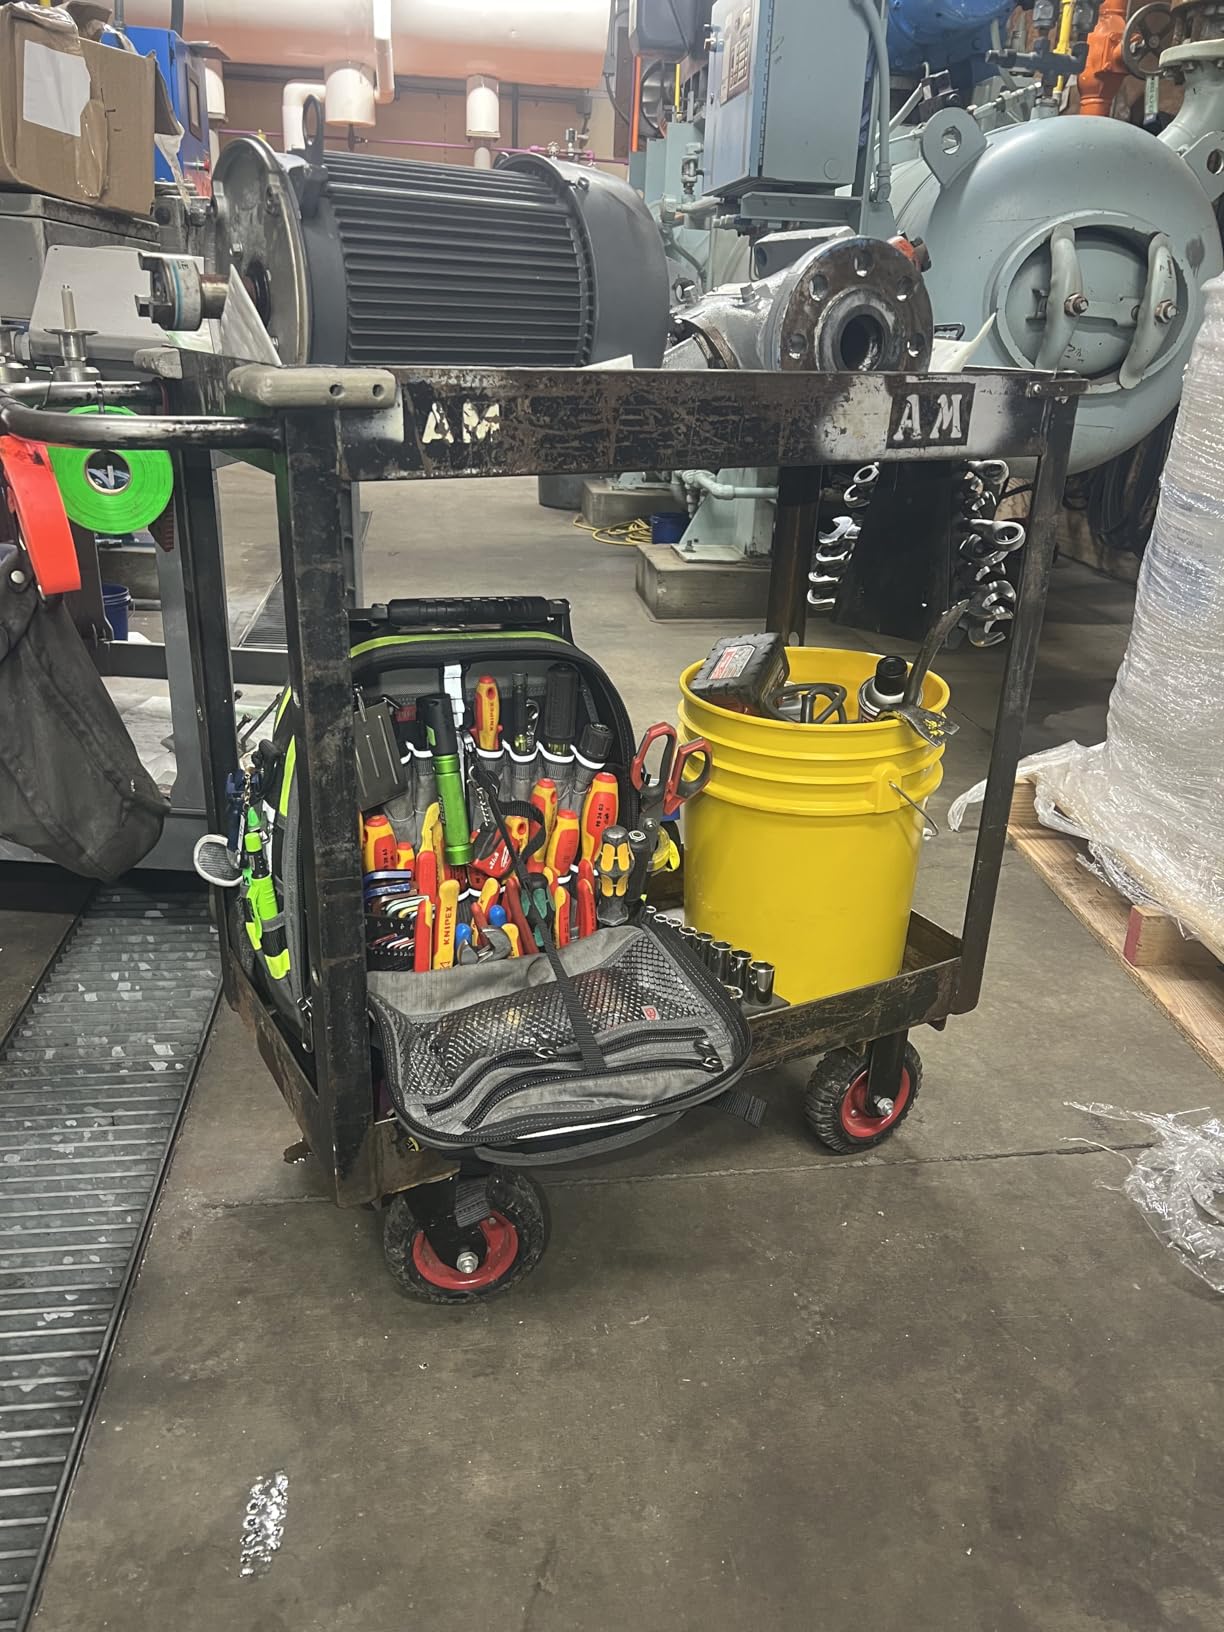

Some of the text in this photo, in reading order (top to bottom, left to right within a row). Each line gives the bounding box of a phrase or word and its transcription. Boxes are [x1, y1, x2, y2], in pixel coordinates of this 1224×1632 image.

[422, 399, 501, 444] AM
[893, 393, 963, 441] AM
[443, 906, 453, 945] KNIPEX
